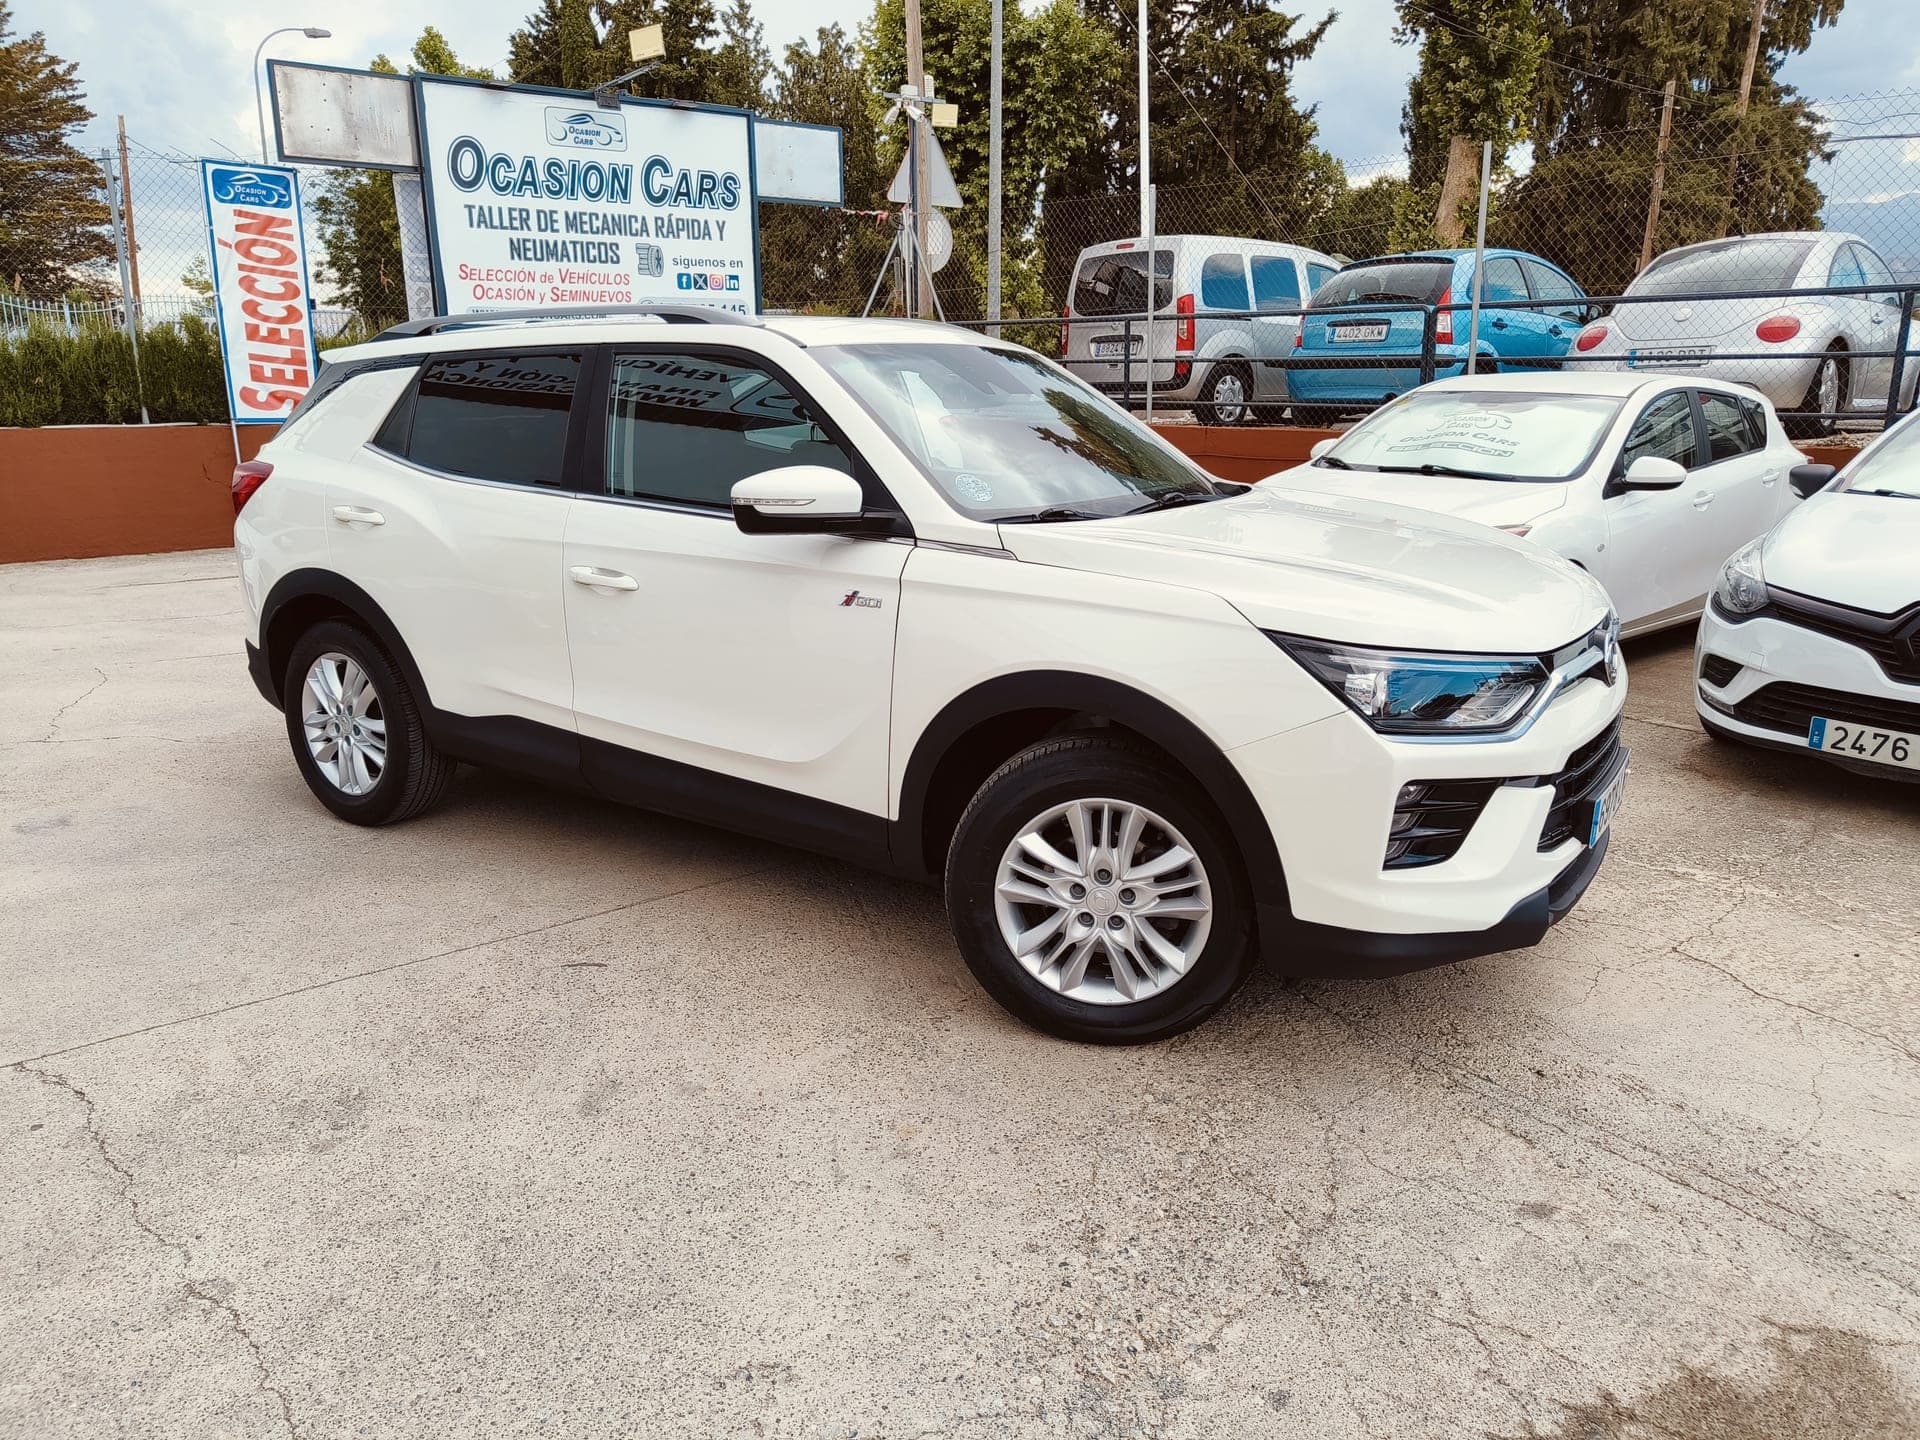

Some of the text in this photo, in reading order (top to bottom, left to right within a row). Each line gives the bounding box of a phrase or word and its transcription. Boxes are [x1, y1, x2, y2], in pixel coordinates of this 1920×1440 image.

[569, 126, 601, 137] OCASION
[573, 136, 594, 146] CARS
[447, 135, 741, 211] OCASION CARS
[234, 185, 267, 196] OCASION
[240, 194, 260, 204] CARS
[464, 204, 727, 241] TALLER DE MECANICA RÁPIDA Y
[508, 237, 621, 265] NEUMATICOS
[730, 259, 744, 269] en
[458, 263, 631, 286] SELECCIÓN de VEHÍCULOS
[473, 284, 632, 304] OCASIÓN y SEMINUEVOS
[218, 208, 310, 413] SELECCIÓN
[1472, 432, 1520, 447] CARS
[1830, 726, 1910, 762] 2476
